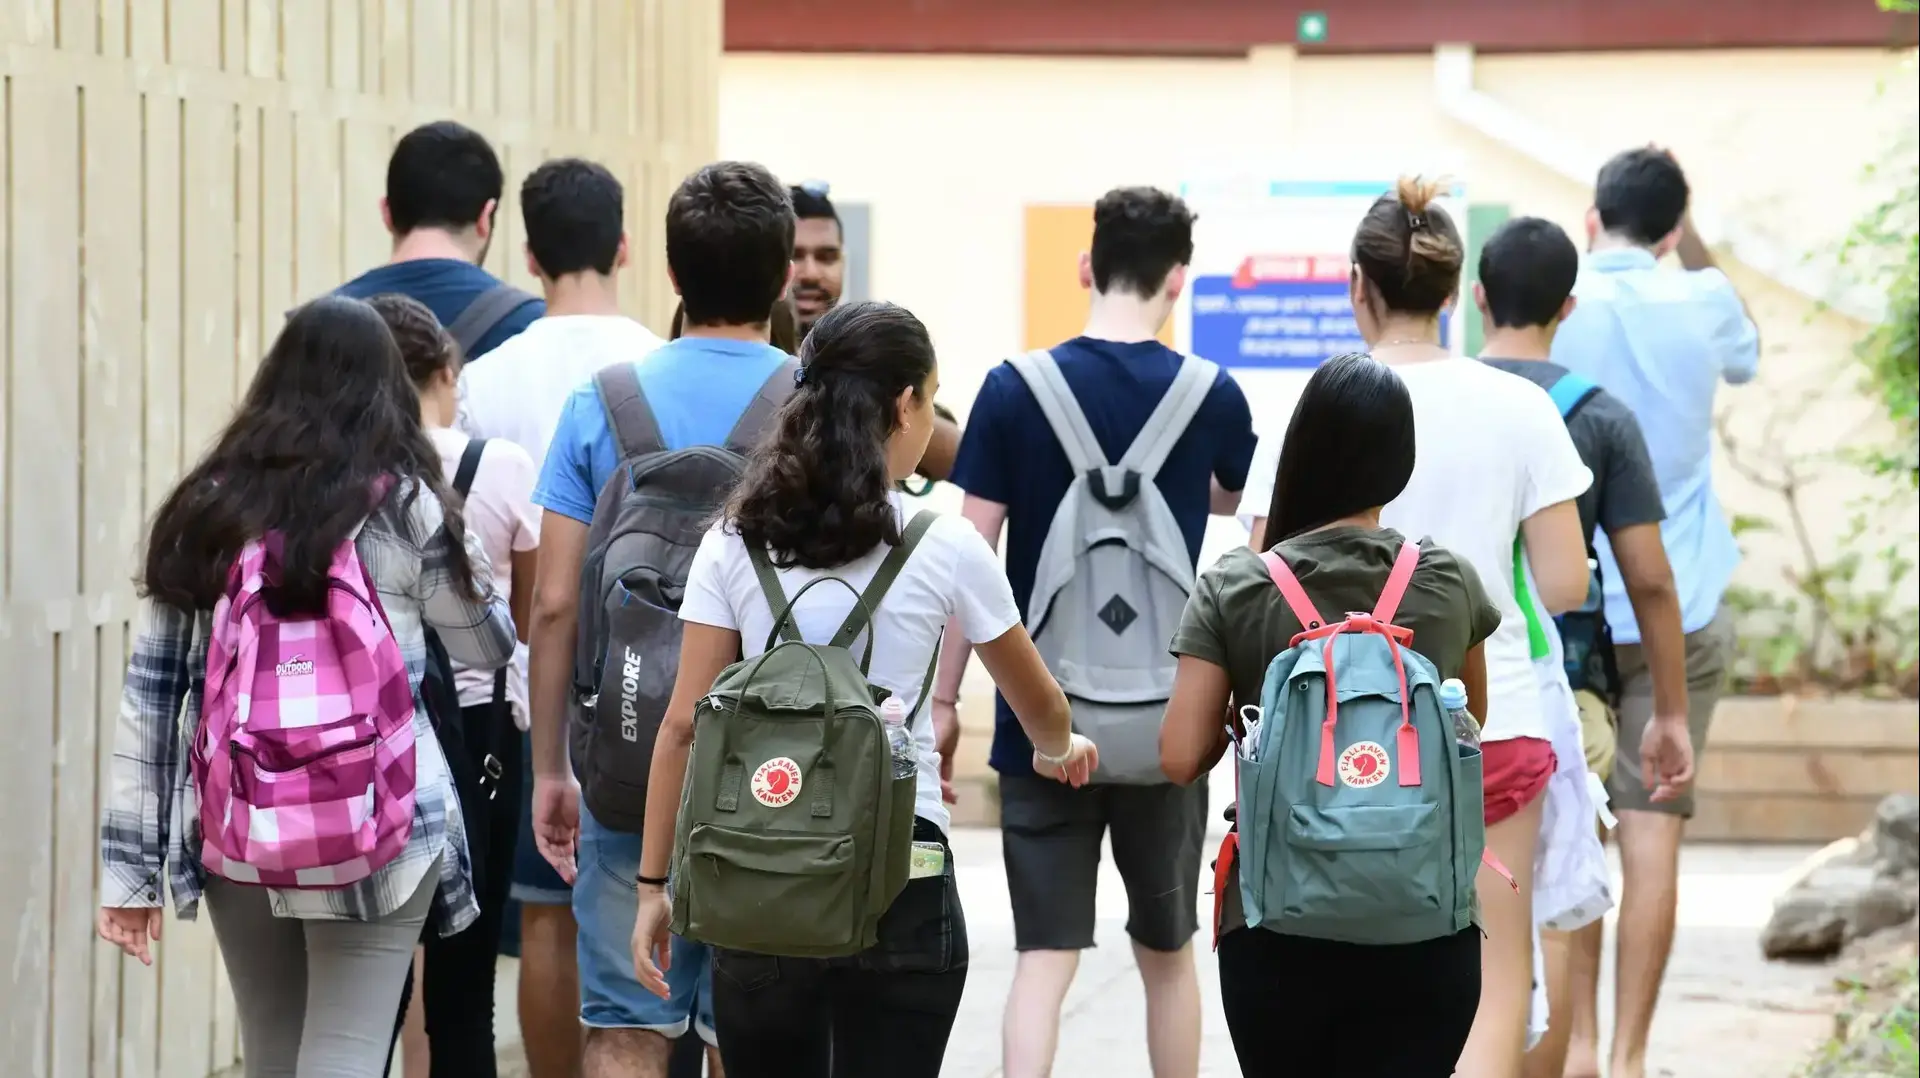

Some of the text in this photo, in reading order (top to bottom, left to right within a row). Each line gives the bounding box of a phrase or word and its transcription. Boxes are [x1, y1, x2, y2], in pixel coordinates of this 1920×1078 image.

[275, 661, 313, 674] OUTDOOR
[621, 645, 641, 742] EXPLORE
[1346, 769, 1385, 785] KANKEN
[755, 788, 795, 804] KANKEN
